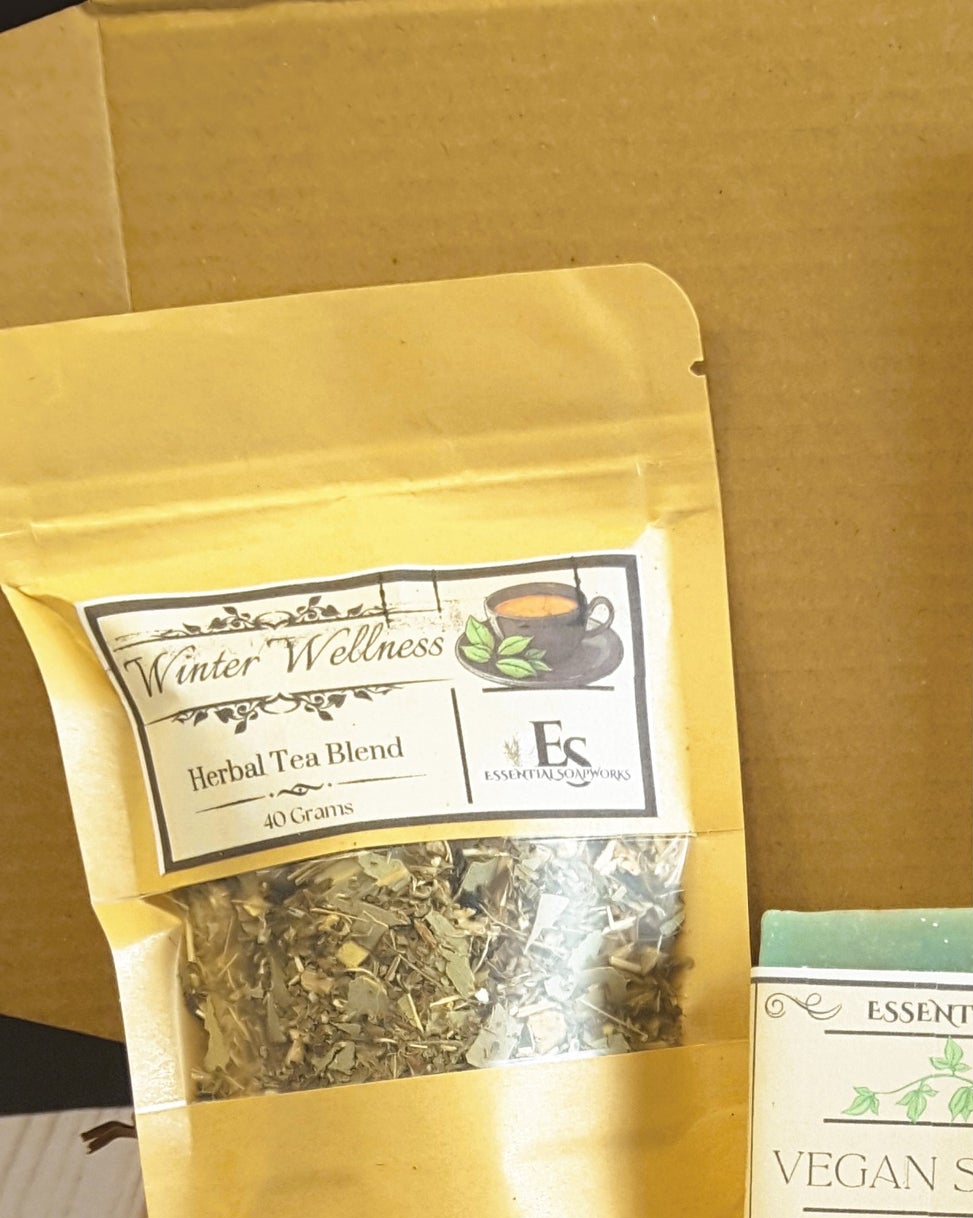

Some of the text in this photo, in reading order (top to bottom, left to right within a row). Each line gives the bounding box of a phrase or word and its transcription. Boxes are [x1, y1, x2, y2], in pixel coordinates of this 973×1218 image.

[124, 623, 445, 698] Winter Wellness
[187, 737, 404, 792] Herbal Tea Blend
[263, 803, 354, 829] 40 Grams
[773, 1150, 937, 1191] VEGAN
